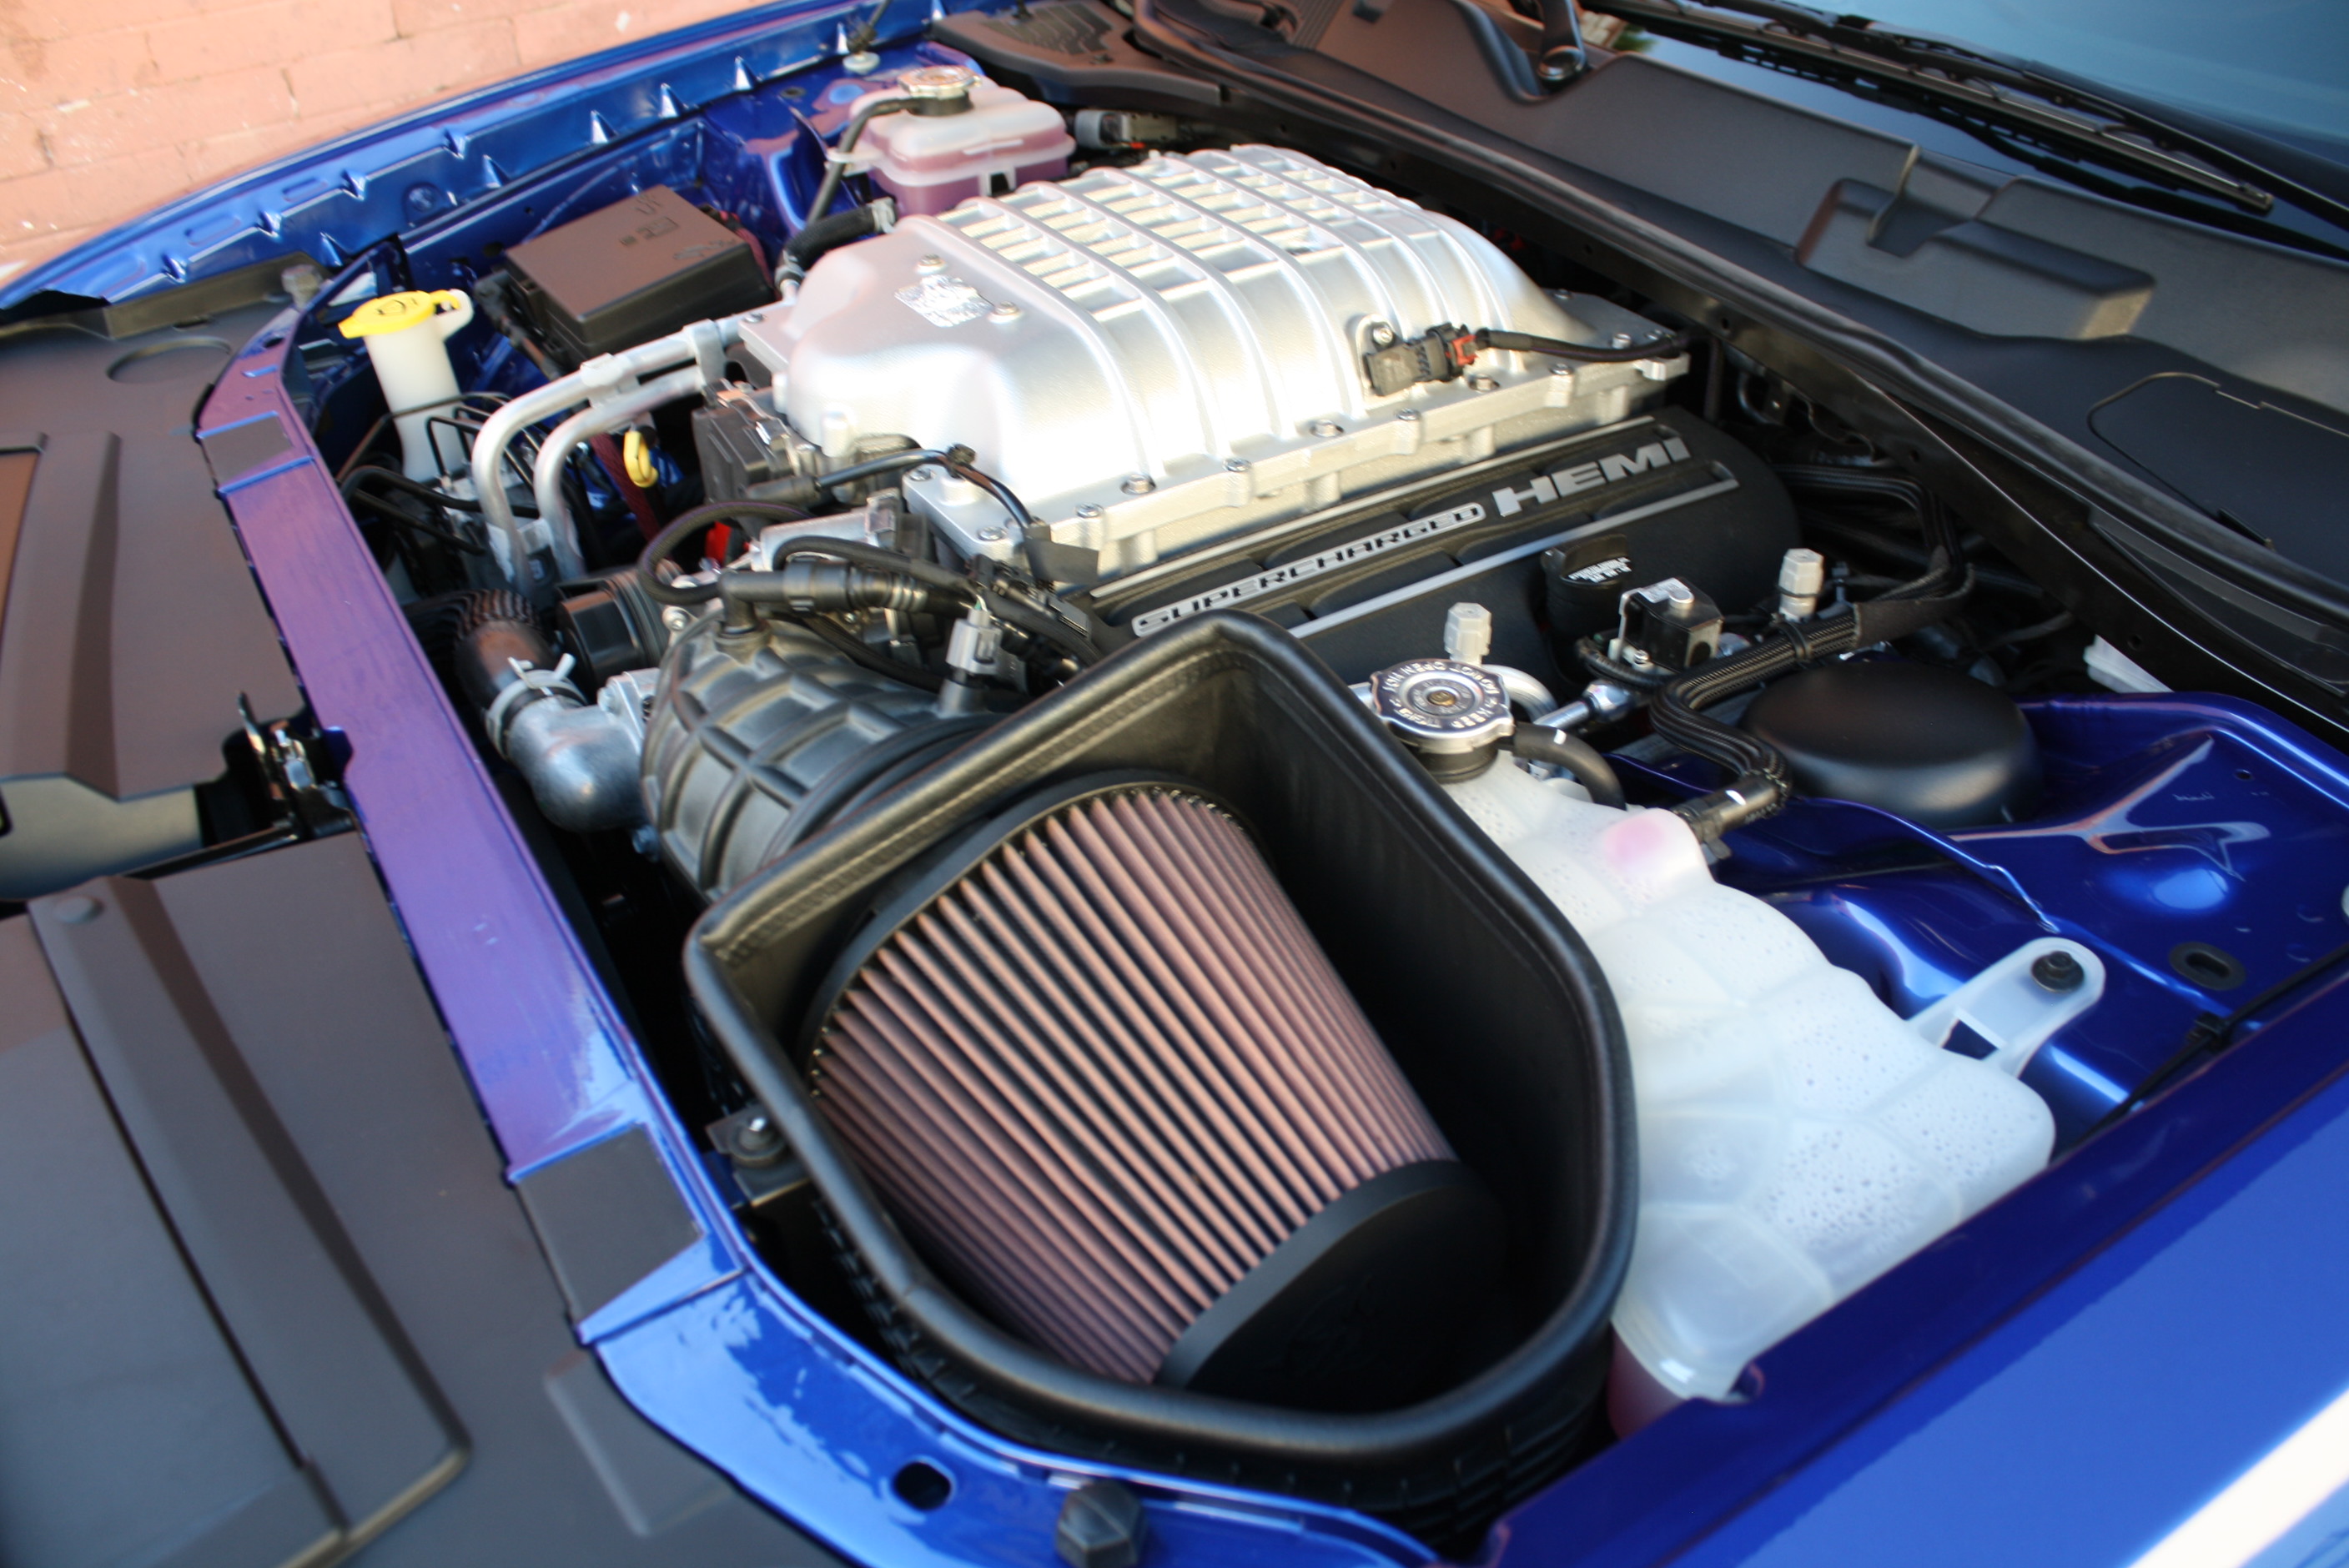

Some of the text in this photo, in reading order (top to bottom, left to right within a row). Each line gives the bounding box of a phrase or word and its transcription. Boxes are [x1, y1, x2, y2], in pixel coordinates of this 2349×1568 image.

[1137, 436, 1692, 631] SUPERCHARGED HEMI
[1401, 661, 1447, 675] OPEN
